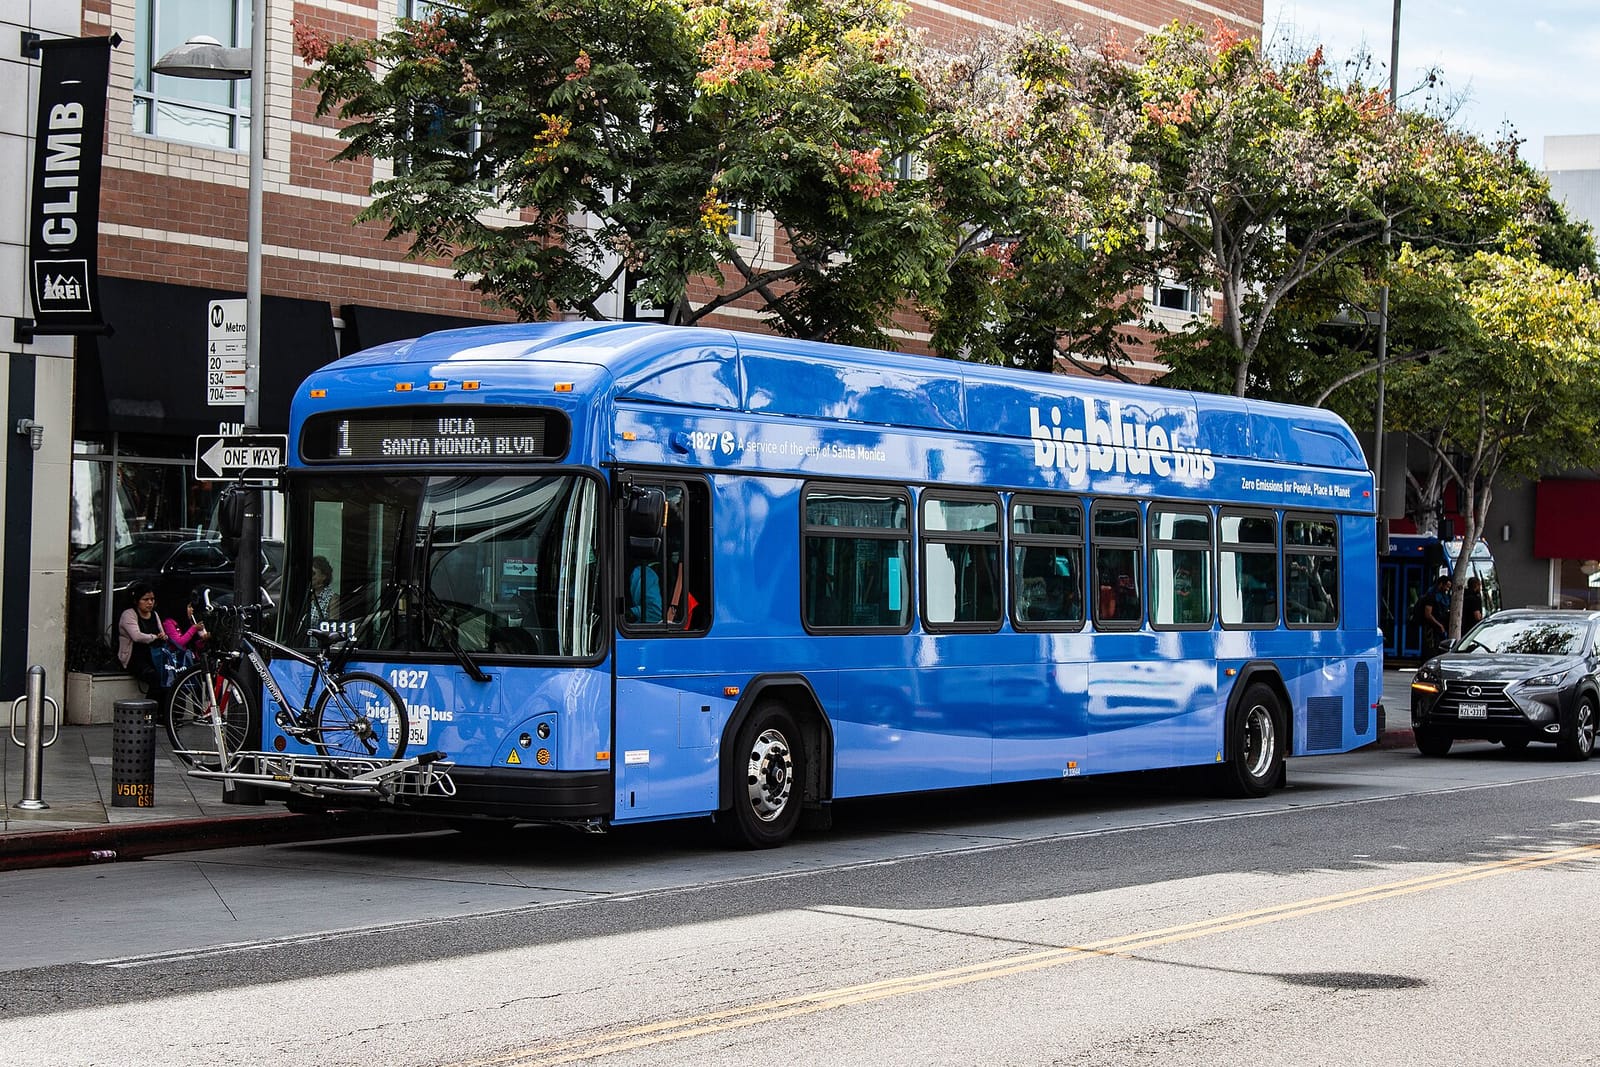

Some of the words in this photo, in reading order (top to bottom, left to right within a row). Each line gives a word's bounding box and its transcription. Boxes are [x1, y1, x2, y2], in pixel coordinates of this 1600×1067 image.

[42, 102, 84, 245] CLIMB
[57, 284, 81, 300] REI
[225, 322, 246, 332] Metro
[210, 342, 216, 354] 4
[210, 357, 221, 370] 20
[209, 372, 224, 385] 534
[209, 388, 224, 400] 704
[219, 422, 245, 436] CLIM
[438, 418, 475, 434] UCLA
[338, 420, 352, 456] 1
[382, 438, 430, 455] SANTA
[434, 437, 491, 454] MONICA
[496, 436, 534, 454] BLVD
[690, 431, 718, 450] 1827
[737, 438, 745, 451] A
[746, 440, 778, 454] service
[780, 441, 788, 455] of
[790, 441, 804, 456] the
[805, 443, 820, 460] city
[822, 445, 830, 457] of
[832, 445, 856, 460] Santa
[857, 446, 886, 462] Monica
[224, 450, 248, 466] ONE
[252, 450, 278, 466] WAY
[1171, 432, 1216, 480] bus
[1241, 477, 1255, 490] Zero
[1255, 479, 1283, 493] Emissions
[1284, 481, 1293, 493] for
[1293, 481, 1313, 496] People,
[1313, 483, 1328, 496] Place
[1328, 485, 1334, 496] &
[1334, 485, 1351, 498] Planet
[390, 670, 429, 689] 1827
[365, 701, 389, 723] big
[431, 707, 453, 721] bus
